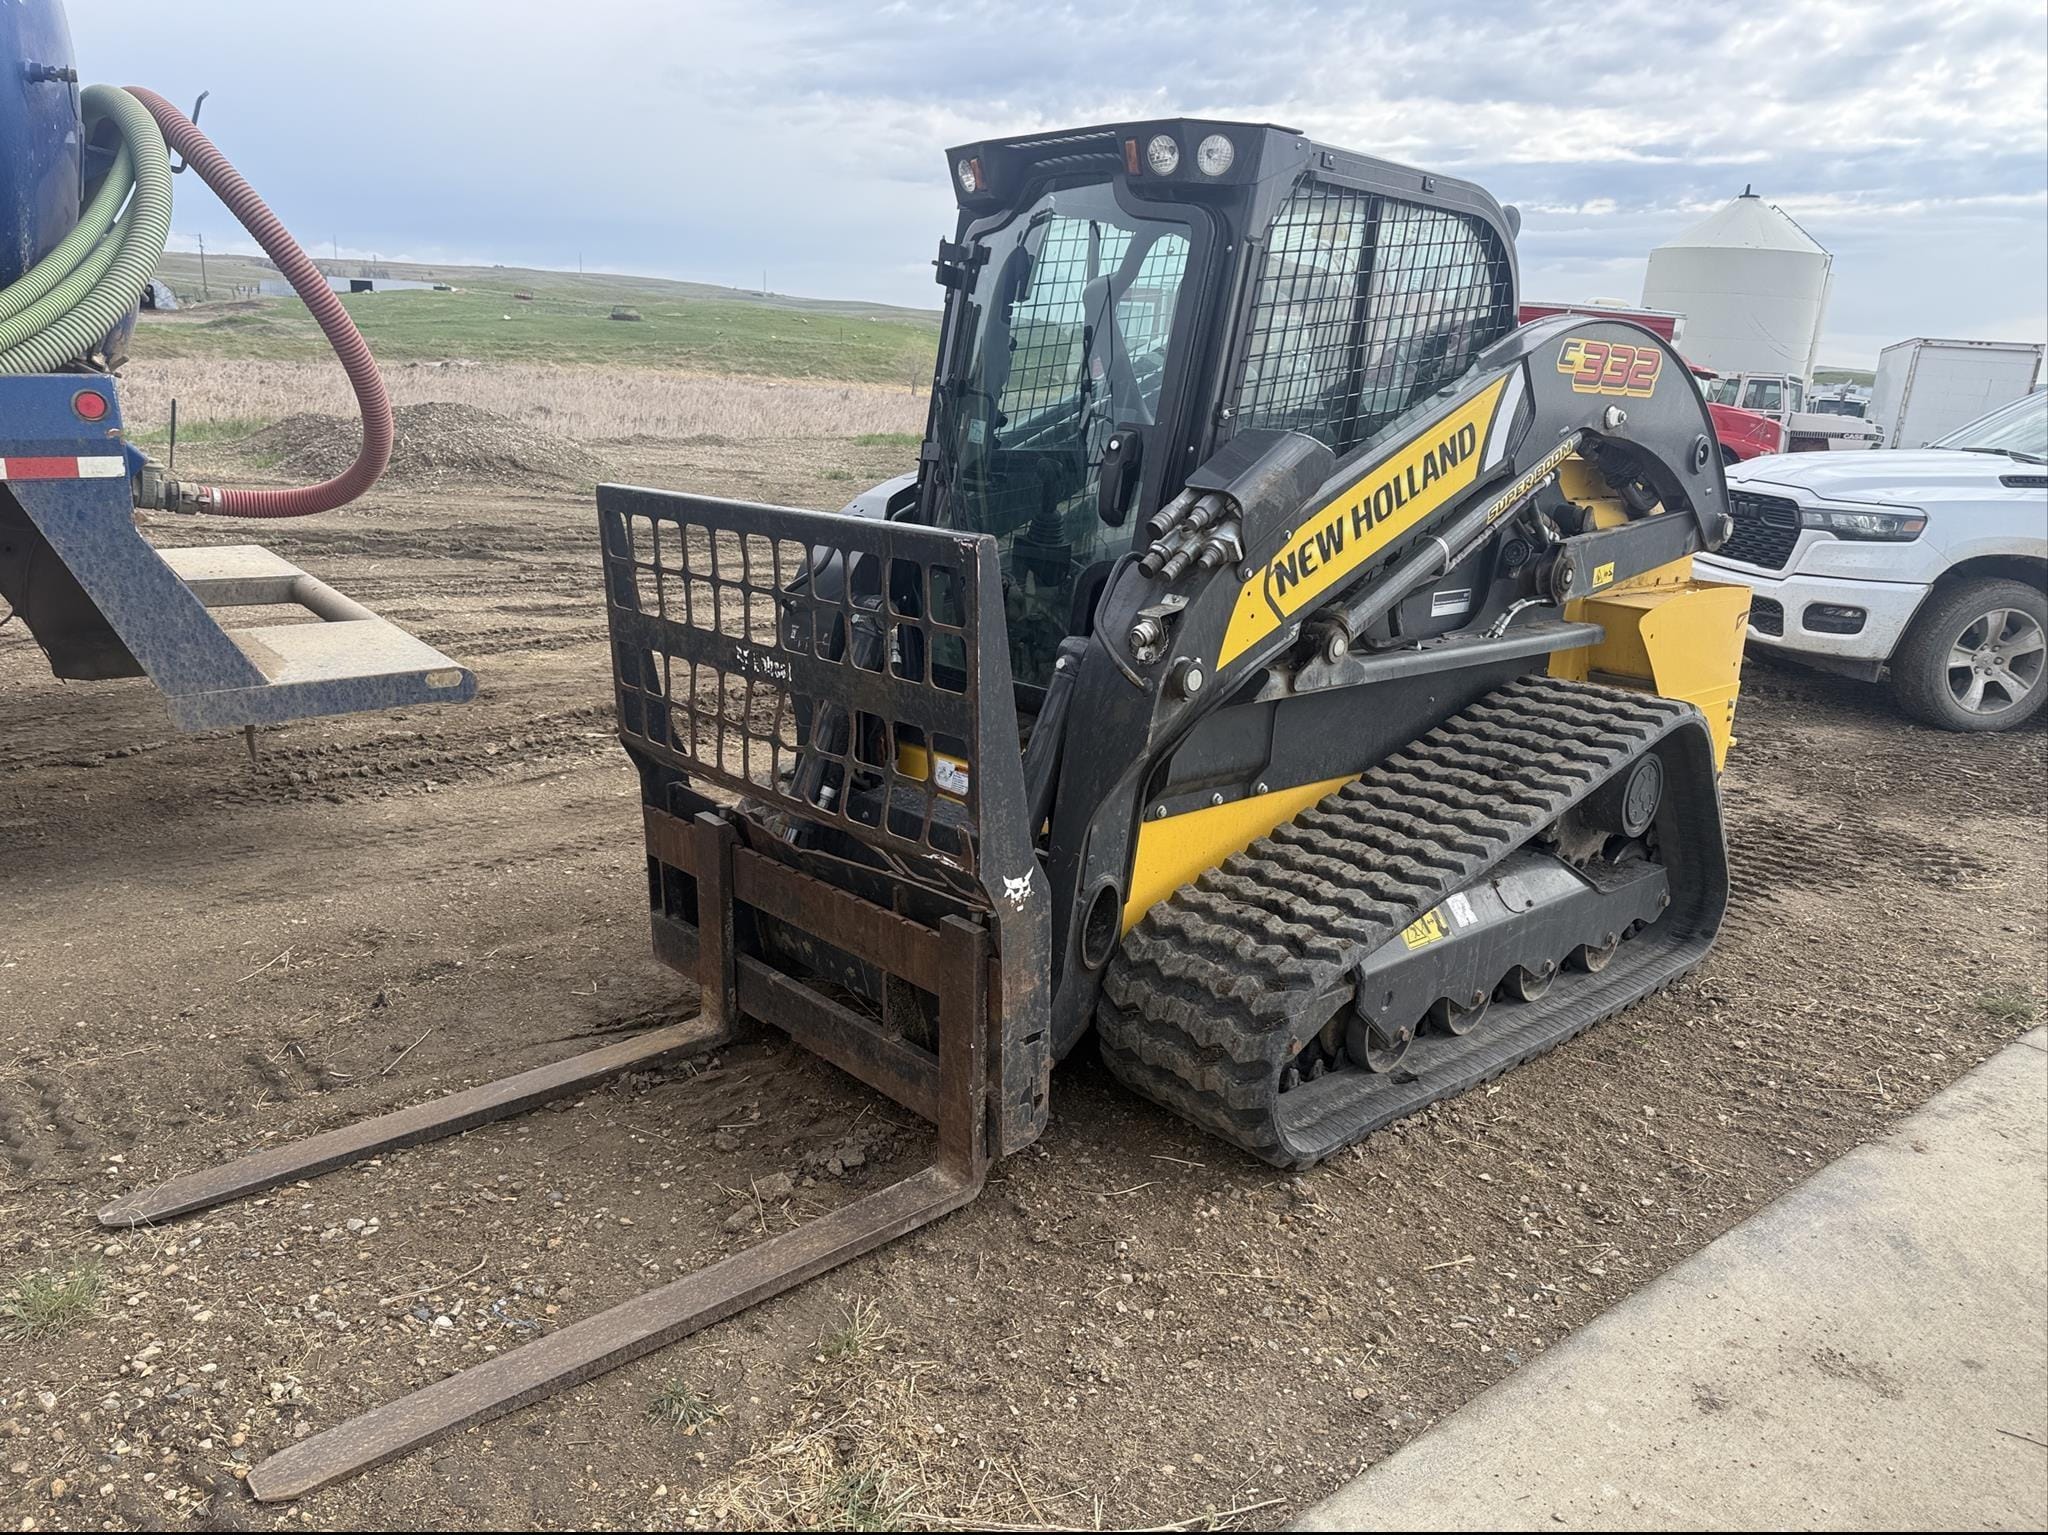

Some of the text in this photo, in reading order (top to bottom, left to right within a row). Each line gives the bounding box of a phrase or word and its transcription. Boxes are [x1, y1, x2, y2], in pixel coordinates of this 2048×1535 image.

[1557, 338, 1662, 397] C332
[1273, 422, 1476, 597] NEW HOLLAND
[1488, 439, 1573, 523] SUPER BOOM
